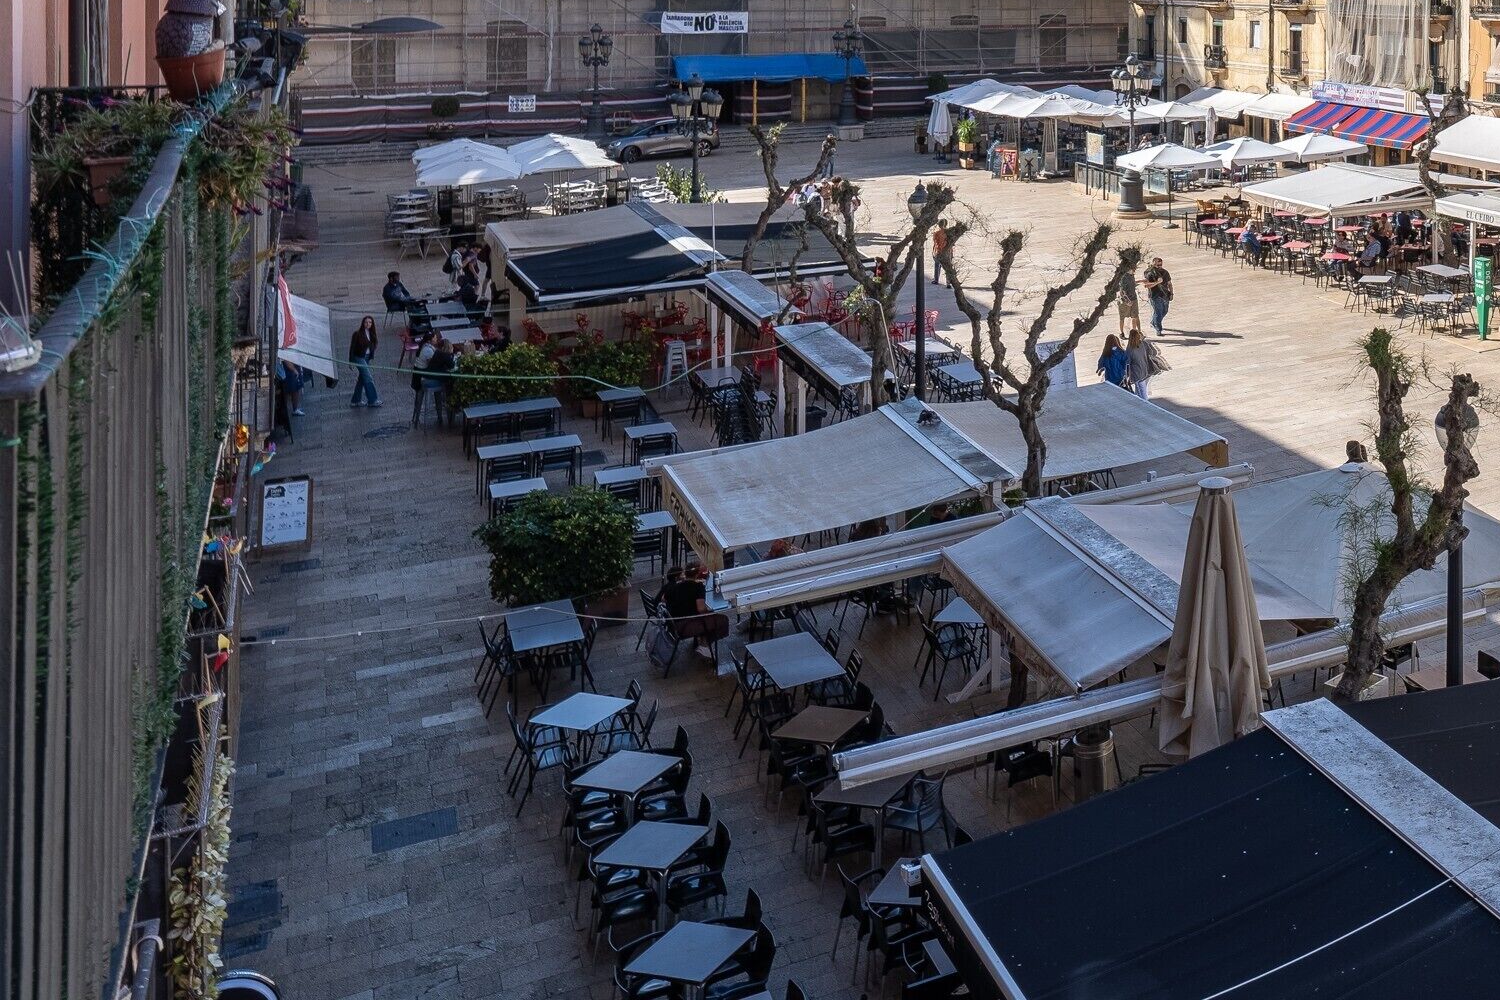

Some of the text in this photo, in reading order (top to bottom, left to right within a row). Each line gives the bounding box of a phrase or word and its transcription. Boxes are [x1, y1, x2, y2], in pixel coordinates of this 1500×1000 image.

[694, 15, 715, 31] NO
[1466, 210, 1495, 224] EL CEIBO
